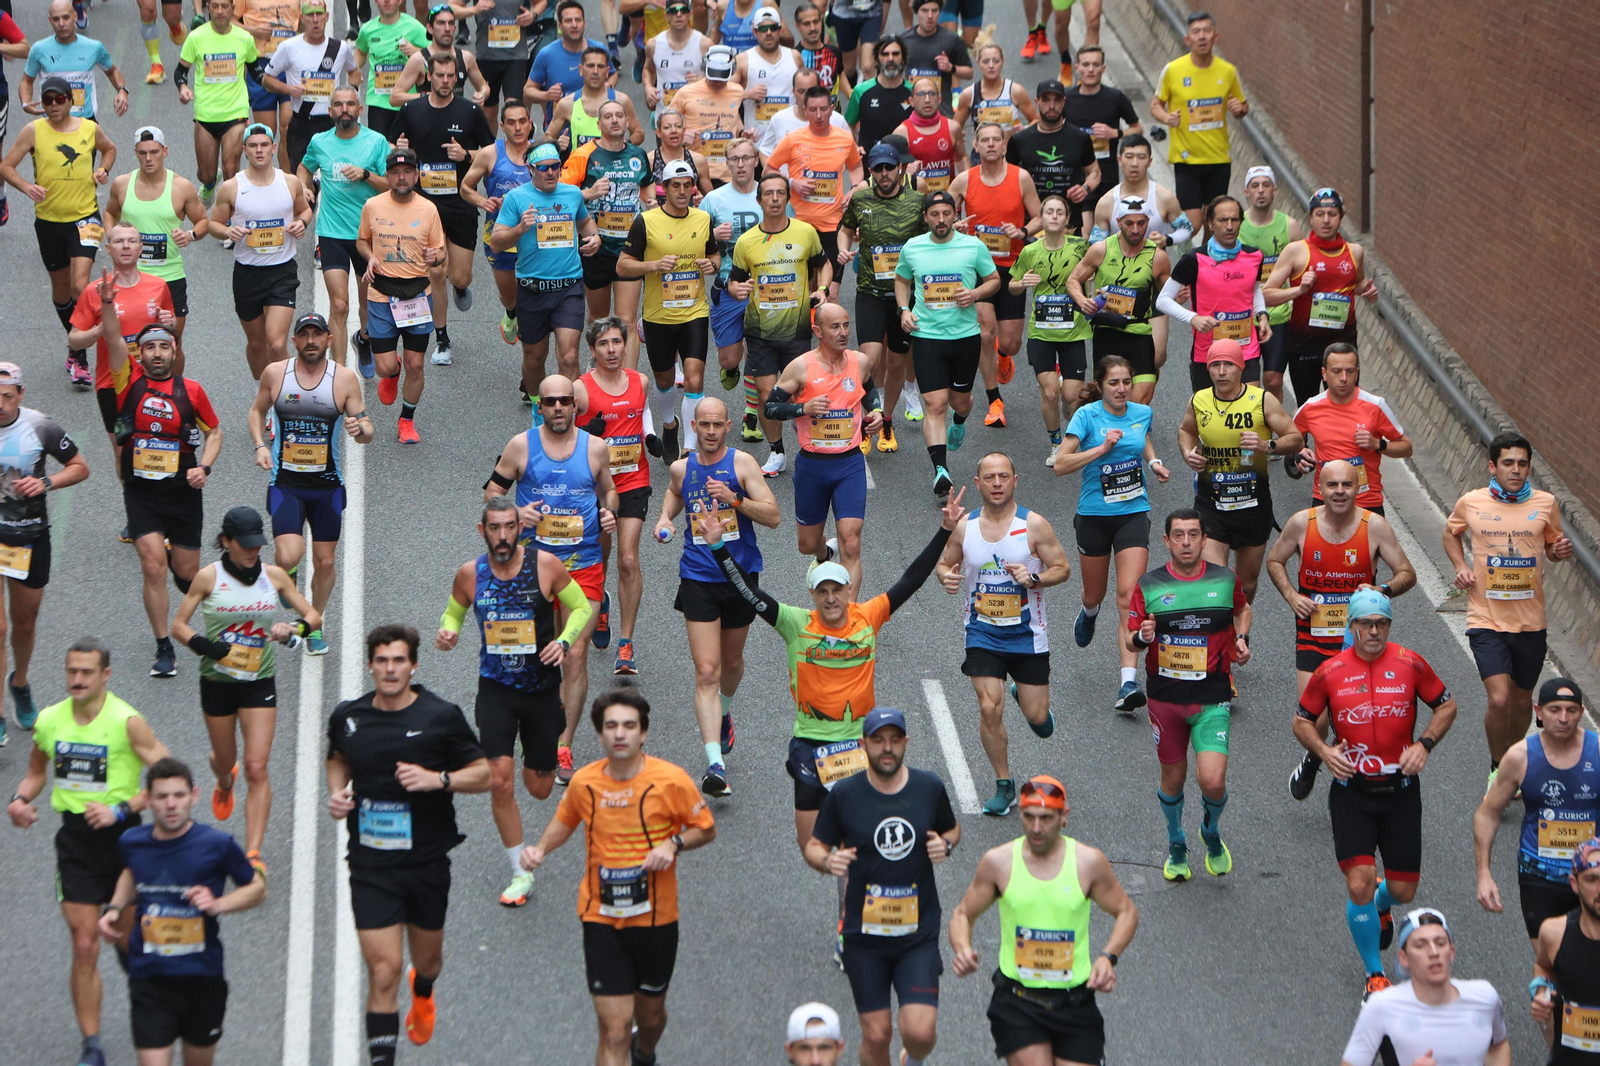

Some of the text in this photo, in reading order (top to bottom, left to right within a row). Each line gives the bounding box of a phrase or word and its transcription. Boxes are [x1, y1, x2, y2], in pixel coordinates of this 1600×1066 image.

[313, 70, 332, 78] ZURICH
[259, 220, 280, 228] ZURICH
[770, 275, 792, 283] ZURICH
[1110, 286, 1132, 296] ZURICH
[1047, 306, 1062, 314] 3440
[1227, 312, 1249, 320] ZURICH
[825, 410, 849, 418] ZURICH
[1224, 411, 1254, 430] 428
[824, 423, 840, 431] 4818
[616, 436, 638, 444] ZURICH
[148, 441, 174, 450] ZURICH
[1203, 445, 1242, 458] MONKEY
[1114, 460, 1138, 471] ZURICH
[1226, 472, 1252, 481] ZURICH
[1226, 486, 1243, 494] 2804
[1481, 529, 1533, 538] Maratón Sevilla
[1503, 558, 1531, 567] ZURICH
[1305, 569, 1367, 579] Club Atletismo
[1305, 577, 1363, 590] GERENA
[988, 585, 1016, 594] ZURICH
[988, 599, 1005, 607] 5238
[1326, 609, 1343, 617] 4327
[1173, 637, 1203, 646] ZURICH
[1172, 651, 1190, 660] 4878
[1169, 662, 1194, 670] ANTONIO
[1337, 703, 1408, 724] EXTREME
[830, 741, 858, 753] ZURICH
[825, 770, 850, 782] ANTONIO
[1558, 811, 1590, 820] ZURICH
[1557, 827, 1578, 837] 5513
[884, 888, 913, 897] ZURICH
